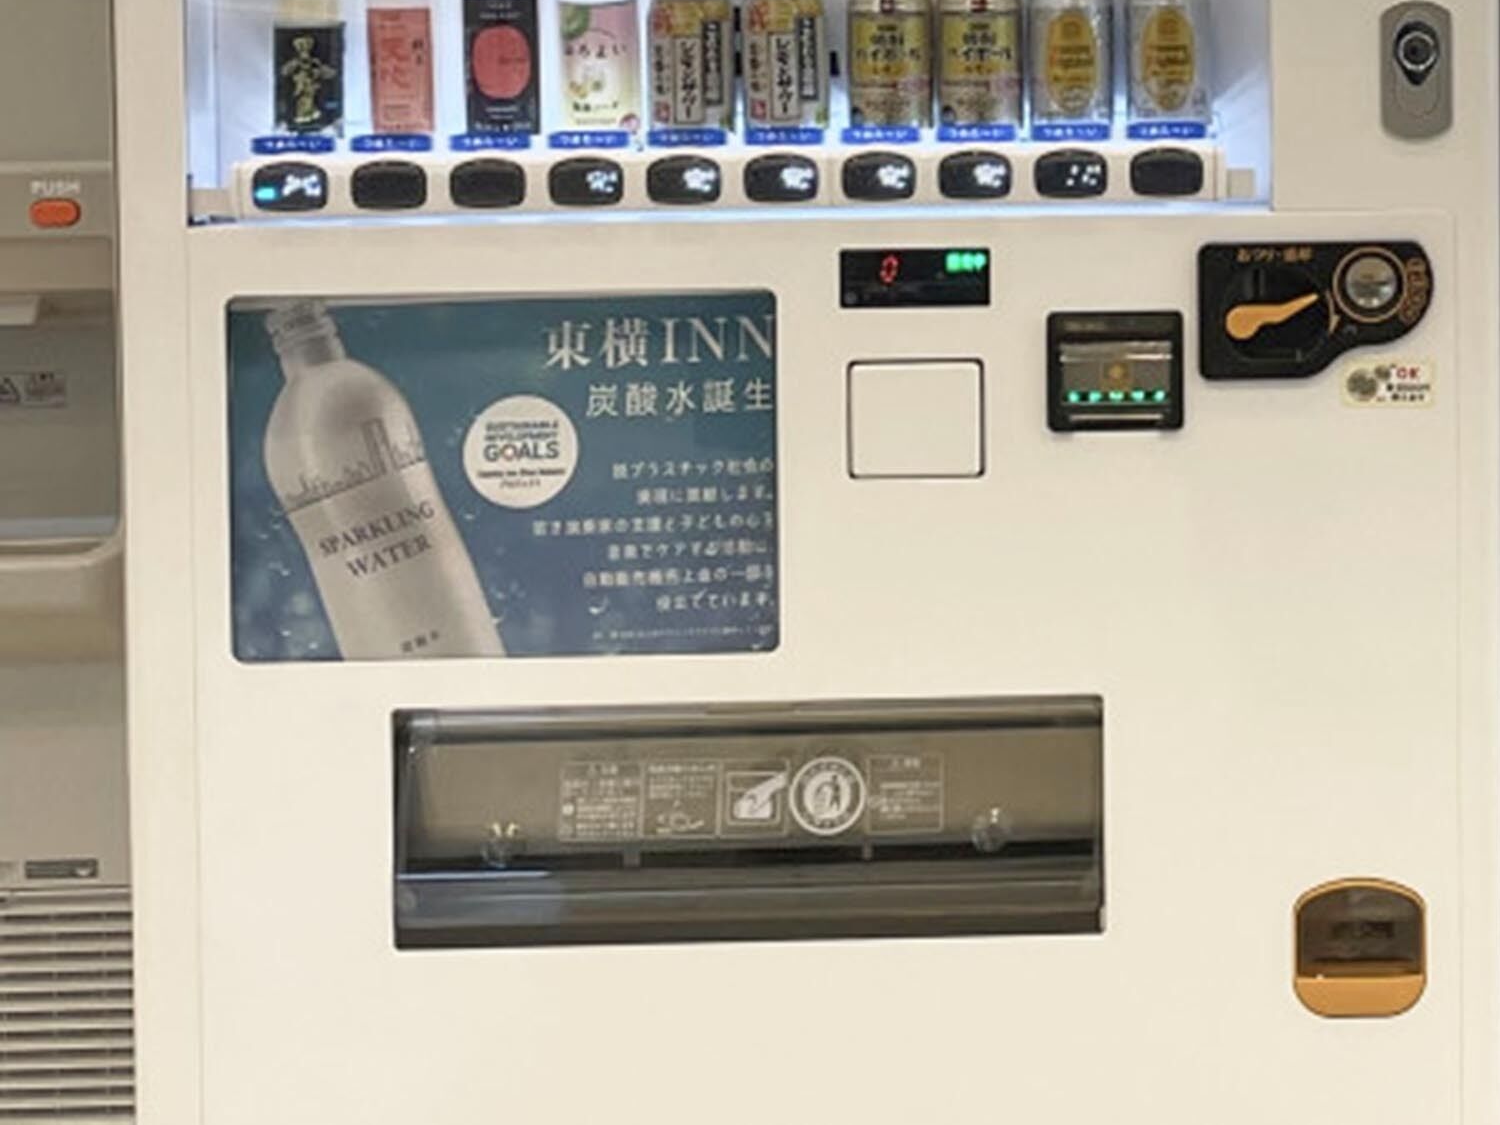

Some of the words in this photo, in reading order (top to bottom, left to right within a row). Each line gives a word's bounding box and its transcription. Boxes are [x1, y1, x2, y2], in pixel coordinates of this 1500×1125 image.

[31, 181, 80, 195] PUSH
[545, 314, 775, 371] 東横INN
[585, 377, 774, 418] 炭酸水誕生
[484, 441, 559, 462] GOALS
[318, 501, 435, 558] SPARKLING
[344, 534, 433, 579] WATER
